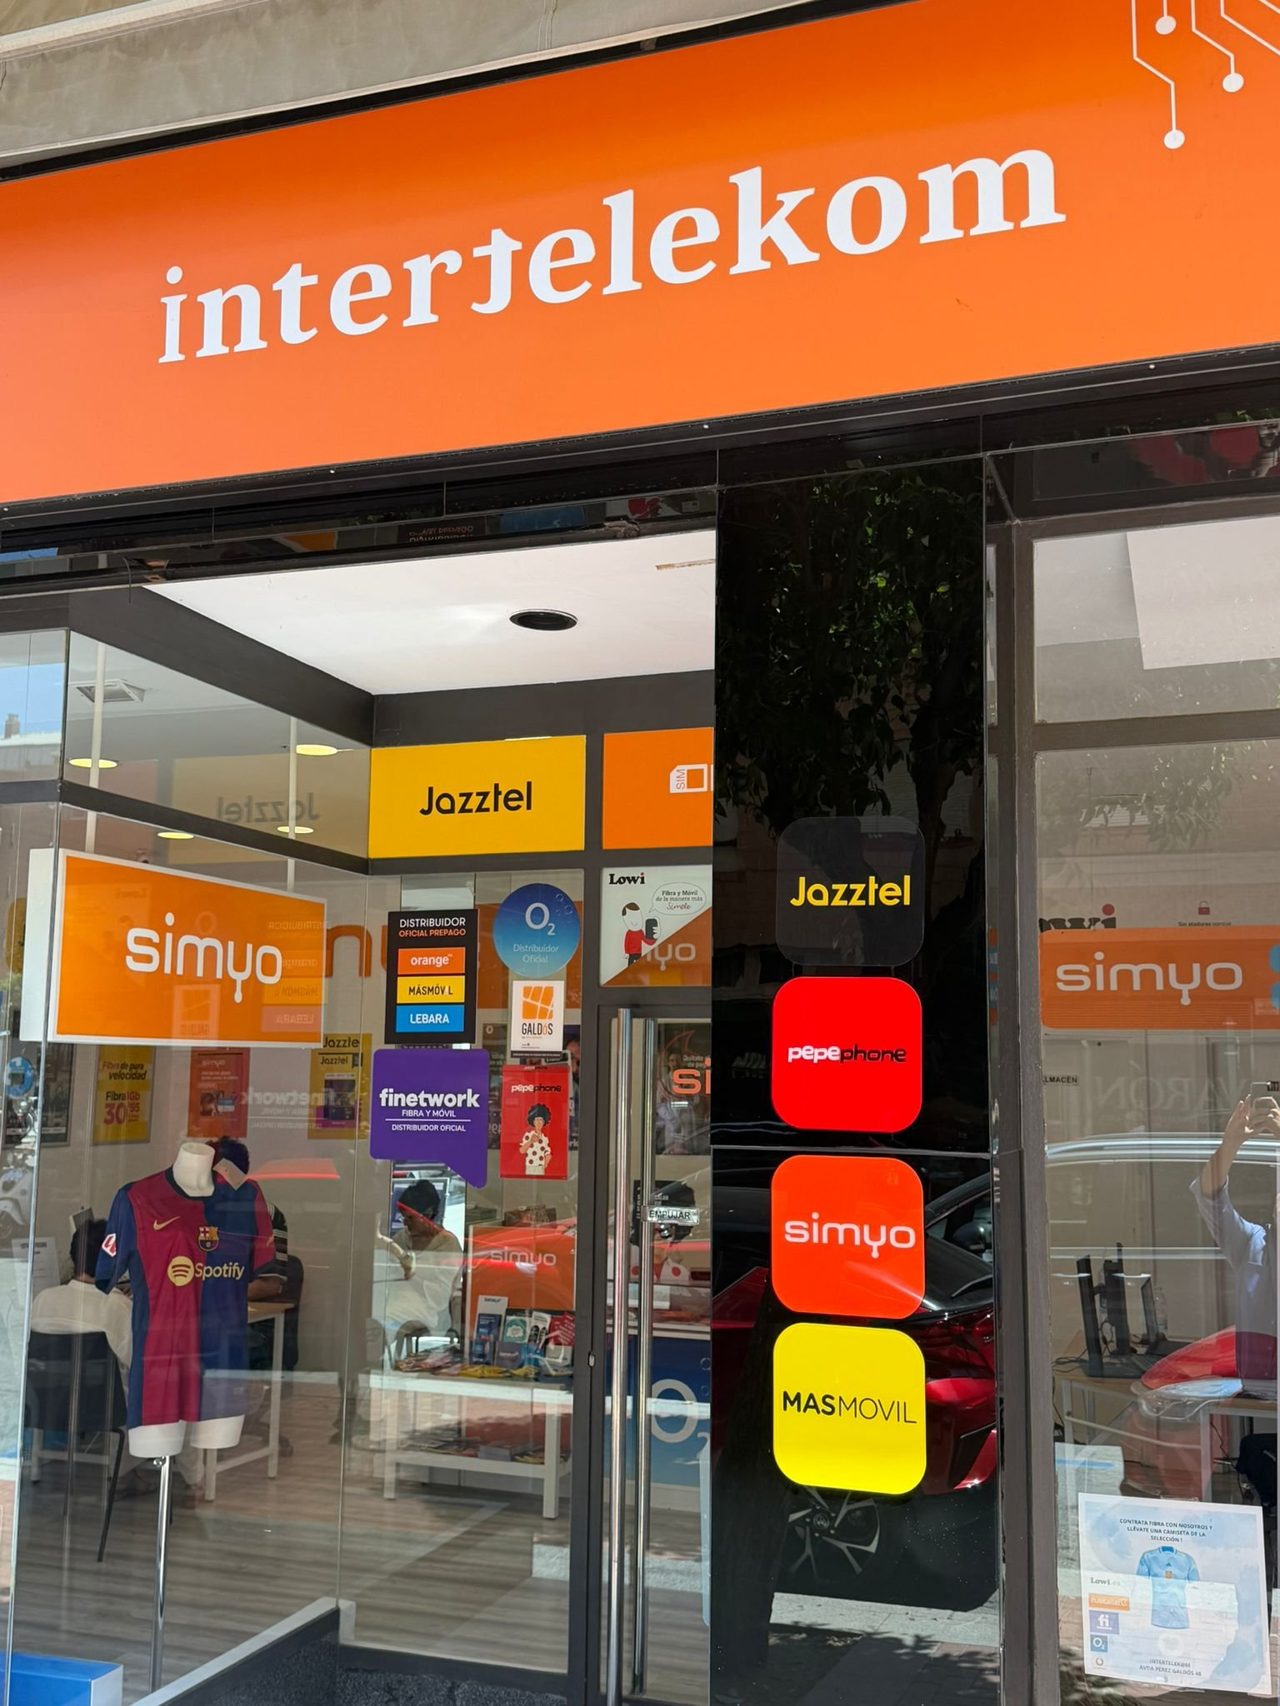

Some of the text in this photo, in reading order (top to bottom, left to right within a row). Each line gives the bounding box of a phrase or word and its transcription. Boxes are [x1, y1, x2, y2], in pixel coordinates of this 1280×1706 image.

[675, 767, 686, 790] SIM
[419, 781, 533, 816] Jazztel
[608, 872, 645, 885] Lowi
[789, 875, 911, 907] Jazztel
[400, 917, 466, 928] DISTRIBUIDOR
[398, 928, 466, 938] OFICIAL PREPAGO
[512, 943, 559, 953] Distribuidor
[125, 912, 283, 1003] simyo
[410, 956, 450, 968] orange
[522, 954, 548, 964] Oficial
[1056, 951, 1243, 1006] simyo
[410, 1014, 450, 1024] LEBARA
[788, 1043, 908, 1064] pepephone
[511, 1083, 562, 1093] pepephone
[379, 1088, 480, 1108] finetwork
[432, 1109, 456, 1117] MÓVIL
[440, 1124, 466, 1132] OFICIAL
[649, 1210, 691, 1220] EMPUJAR
[784, 1212, 916, 1258] simyo
[194, 1262, 245, 1282] Spotify
[782, 1391, 918, 1424] MASMOVIL
